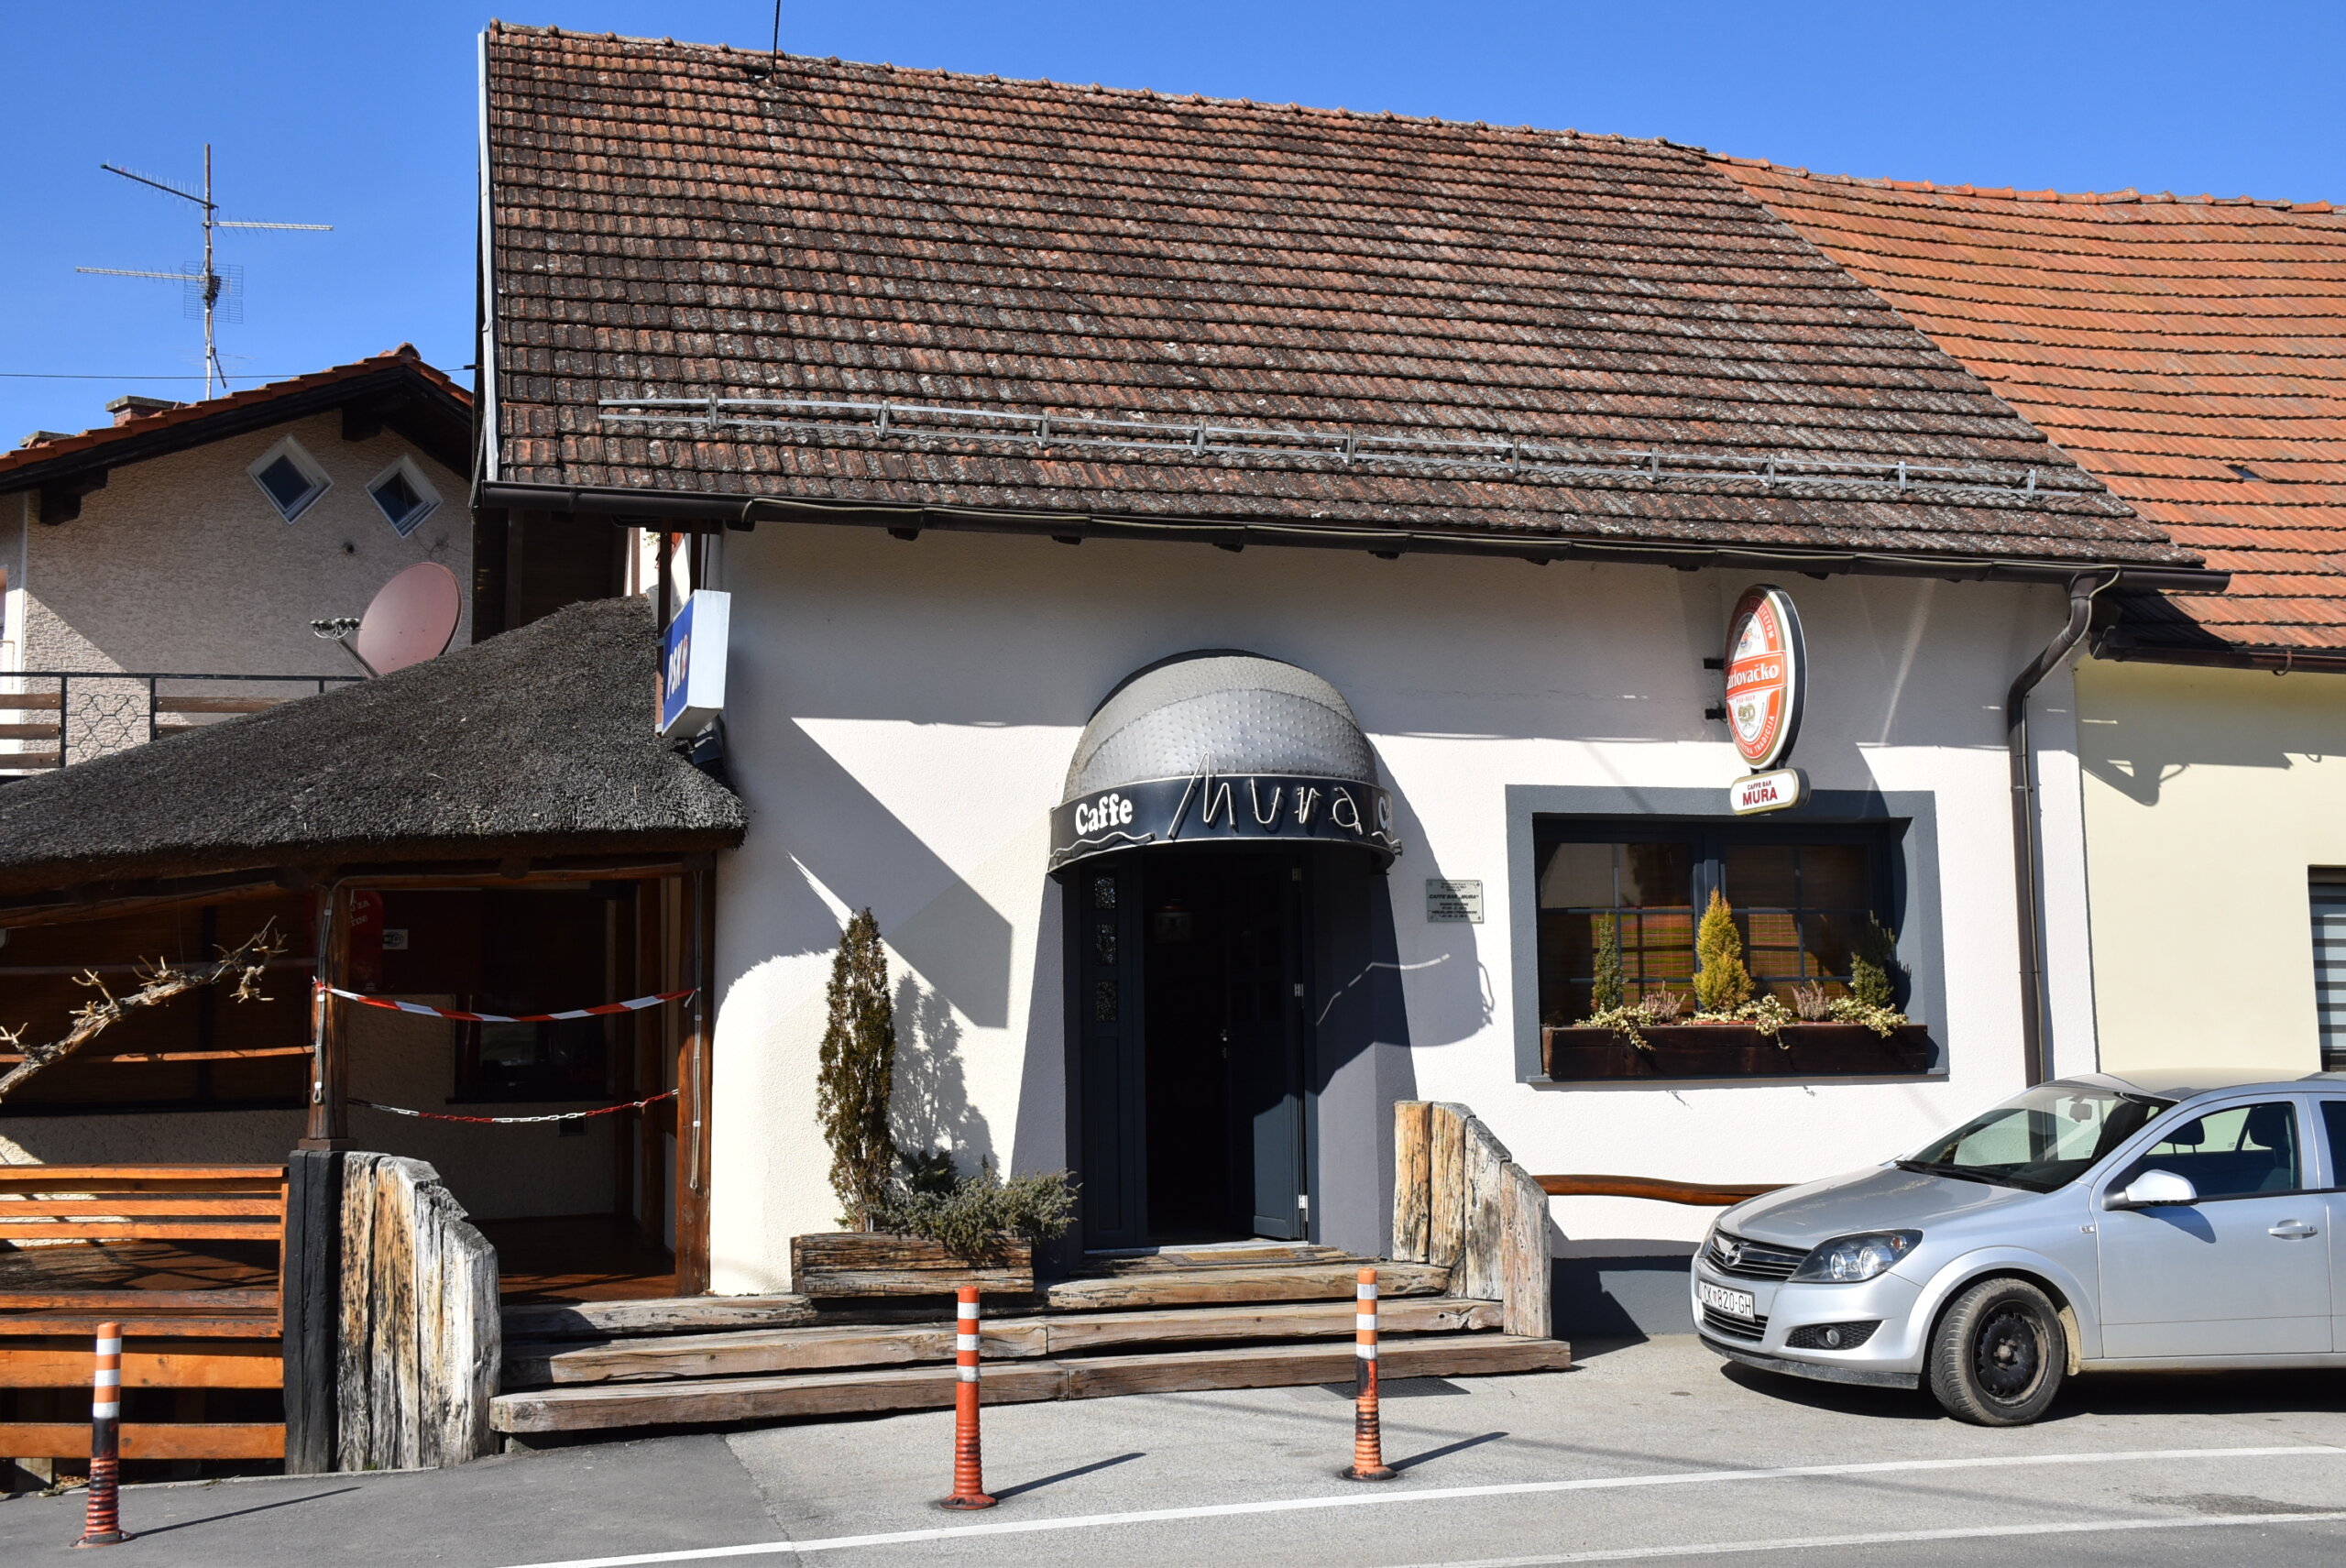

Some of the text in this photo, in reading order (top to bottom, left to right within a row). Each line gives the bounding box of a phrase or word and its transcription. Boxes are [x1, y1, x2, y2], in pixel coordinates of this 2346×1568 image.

[1726, 662, 1780, 690] arlovačko
[1754, 715, 1775, 752] TRADICIJA
[1075, 794, 1133, 835] Caffe
[1168, 751, 1364, 839] Mura
[1742, 787, 1778, 806] MURA
[1747, 780, 1772, 791] CAFFE BAR
